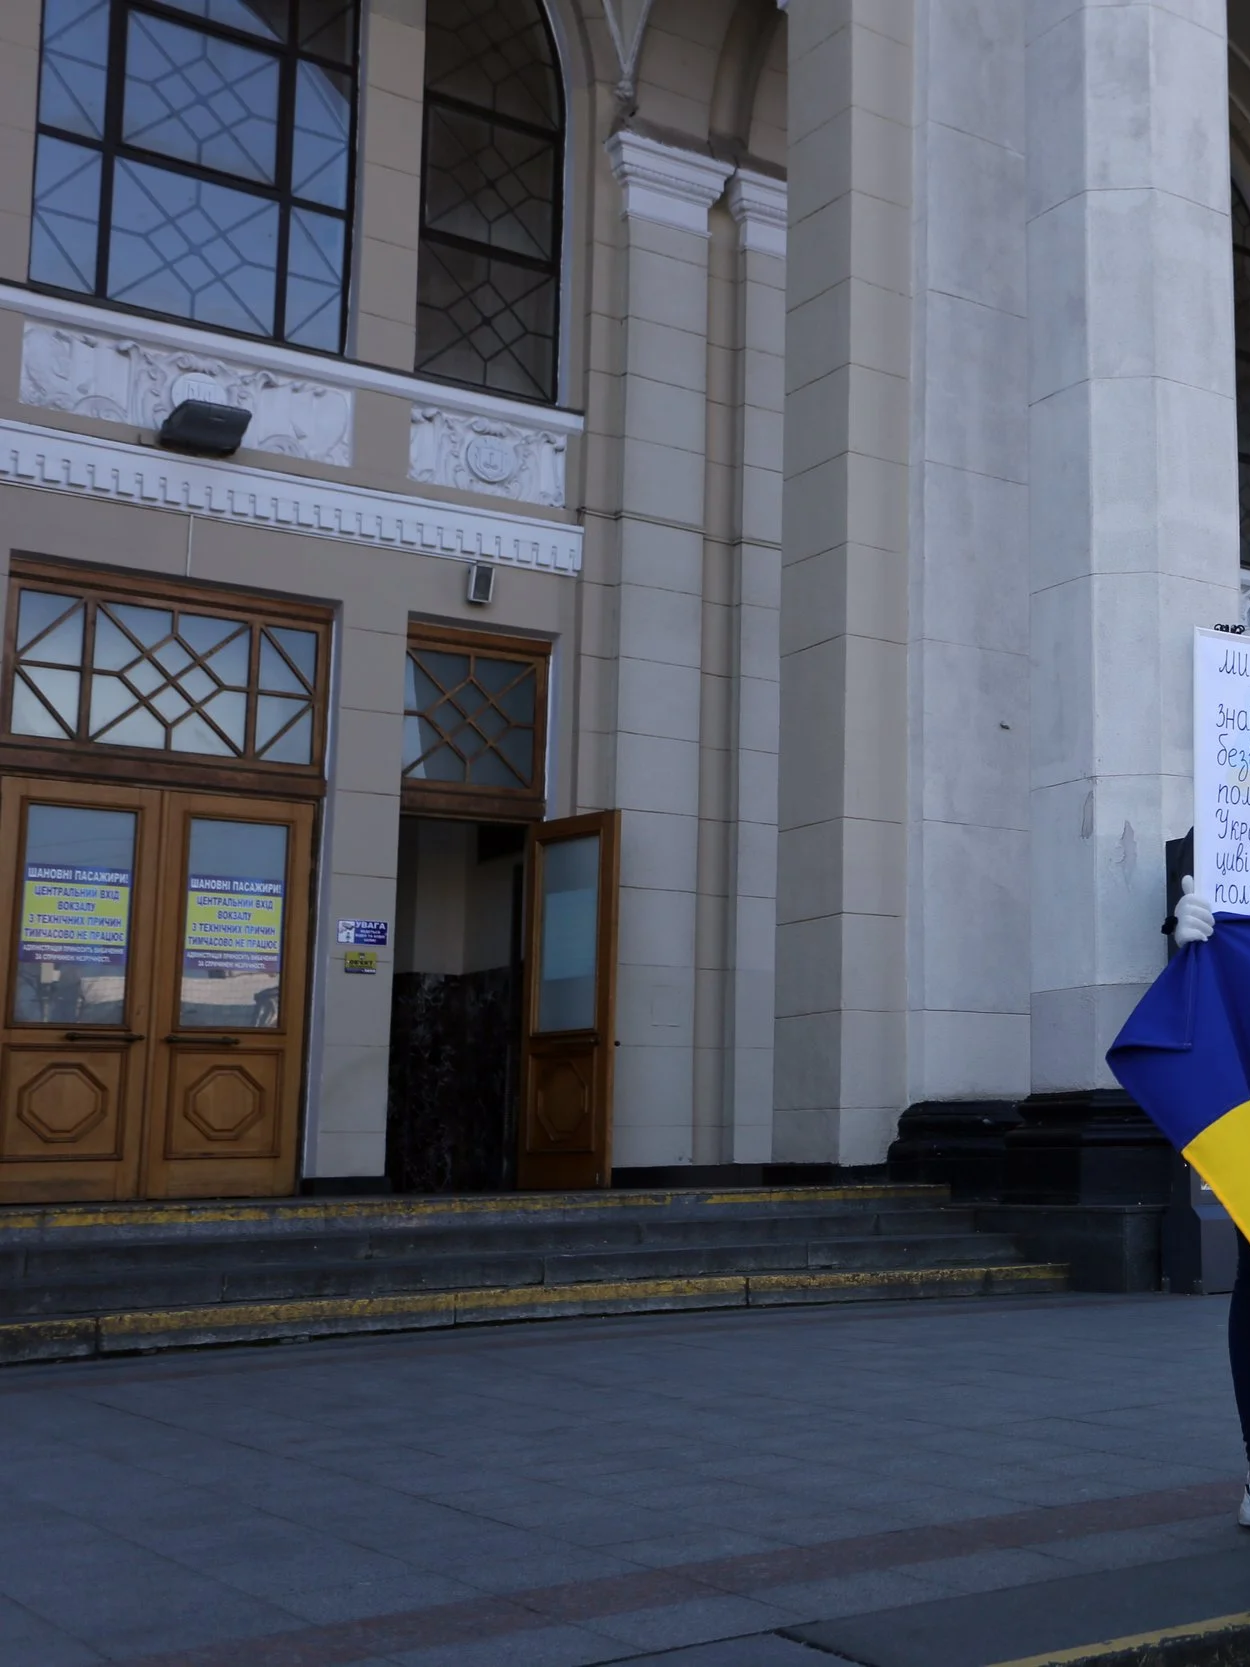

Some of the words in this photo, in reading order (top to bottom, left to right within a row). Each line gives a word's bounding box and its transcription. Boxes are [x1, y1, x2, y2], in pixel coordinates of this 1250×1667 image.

[28, 867, 73, 880] ШАНОВНІ
[74, 870, 129, 884] ПАСАЖИРИ!
[34, 885, 97, 898] ЦЕНТРАЛЬНИЙ
[100, 889, 120, 900] ВХІД
[190, 878, 231, 889] ШАНОВНІ
[232, 881, 282, 894] ПАСАЖИРИ!
[57, 901, 96, 912] ВОКЗАЛУ
[196, 896, 253, 908] ЦЕНТРАЛЬНИЙ
[255, 899, 273, 910] ВХІД
[29, 914, 34, 923] З
[37, 914, 84, 925] ТЕХНІЧНИХ
[88, 917, 122, 927] ПРИЧИН
[217, 910, 252, 920] ВОКЗАЛУ
[192, 923, 197, 931] З
[199, 923, 242, 934] ТЕХНІЧНИХ
[245, 925, 276, 936] ПРИЧИН
[355, 921, 386, 930] УВАГА
[24, 928, 75, 939] ТИМЧАСОВО
[77, 930, 88, 940] НЕ
[90, 931, 124, 942] ПРАЦЮЄ
[188, 936, 233, 947] ТИМЧАСОВО
[235, 939, 245, 947] НЕ
[247, 939, 278, 949] ПРАЦЮЄ
